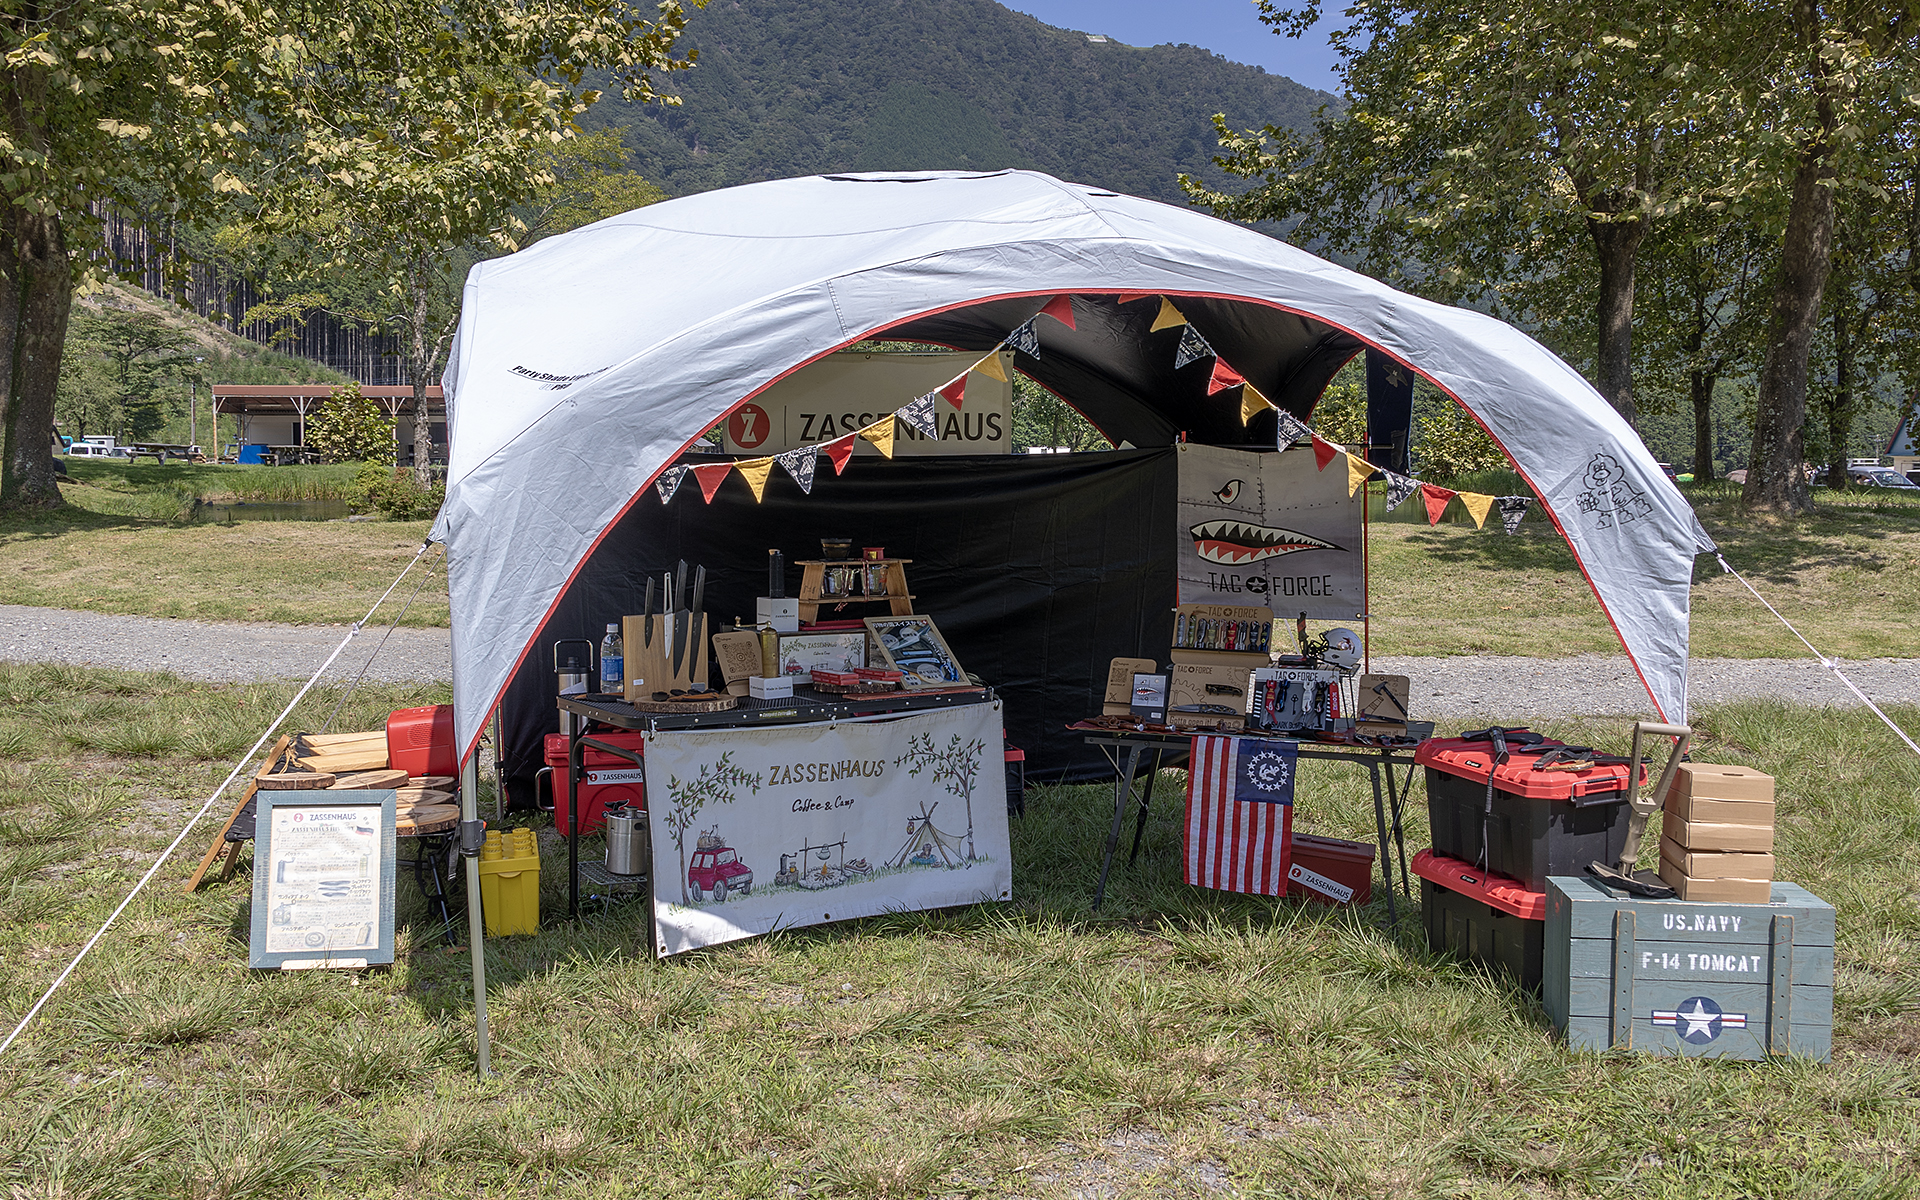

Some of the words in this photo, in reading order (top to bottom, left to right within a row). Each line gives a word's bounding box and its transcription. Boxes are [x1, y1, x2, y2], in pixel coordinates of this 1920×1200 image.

[1207, 571, 1242, 593] TAC
[1272, 574, 1333, 597] FORCE
[1208, 606, 1222, 617] TAC
[1233, 608, 1258, 619] FORCE
[1177, 665, 1188, 673] TAC
[1195, 666, 1213, 674] FORCE
[1275, 670, 1287, 680] TAC
[1296, 671, 1319, 681] FORCE
[602, 772, 642, 781] ZASSENHAUS
[768, 759, 886, 786] ZASSENHAUS
[791, 798, 822, 813] Coffee
[823, 801, 833, 811] &
[834, 795, 855, 809] Camp
[309, 812, 357, 821] ZASSENHAUS
[1305, 875, 1350, 899] ZASSENHAUS
[1663, 913, 1742, 932] US.NAVY
[1642, 951, 1681, 970] F-14
[1687, 953, 1761, 973] TOMCAT
